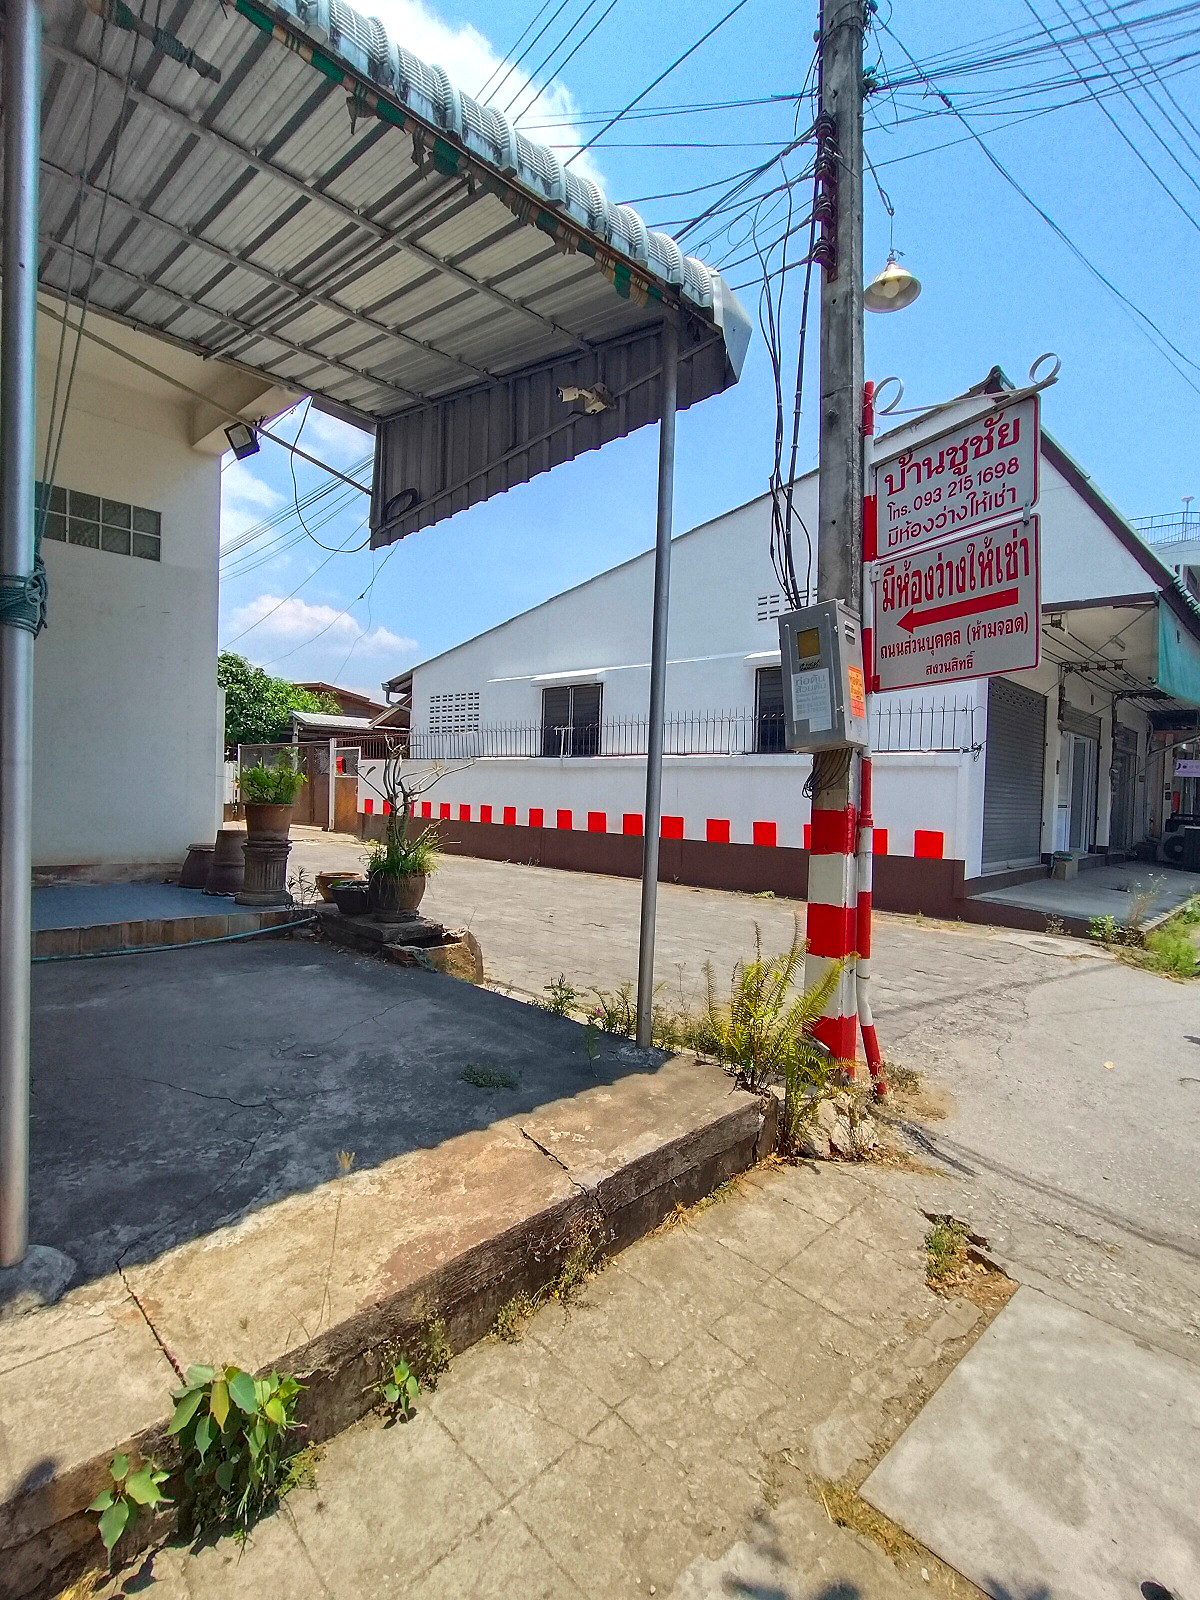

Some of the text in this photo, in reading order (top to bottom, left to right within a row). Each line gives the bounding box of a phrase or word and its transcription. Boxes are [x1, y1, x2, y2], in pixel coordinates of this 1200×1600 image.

[884, 412, 1020, 496] บ้านชูชัย
[887, 456, 1020, 521] โทร. 093 215 1698
[888, 482, 1017, 547] มีห้องว่างให้เช่า
[882, 528, 1030, 612] มีห้องว่างให้เช่า
[880, 611, 1029, 660] ถนนส่วนบุคคล (ห้ามจอด)
[925, 650, 976, 675] สงวนสิทธิ์
